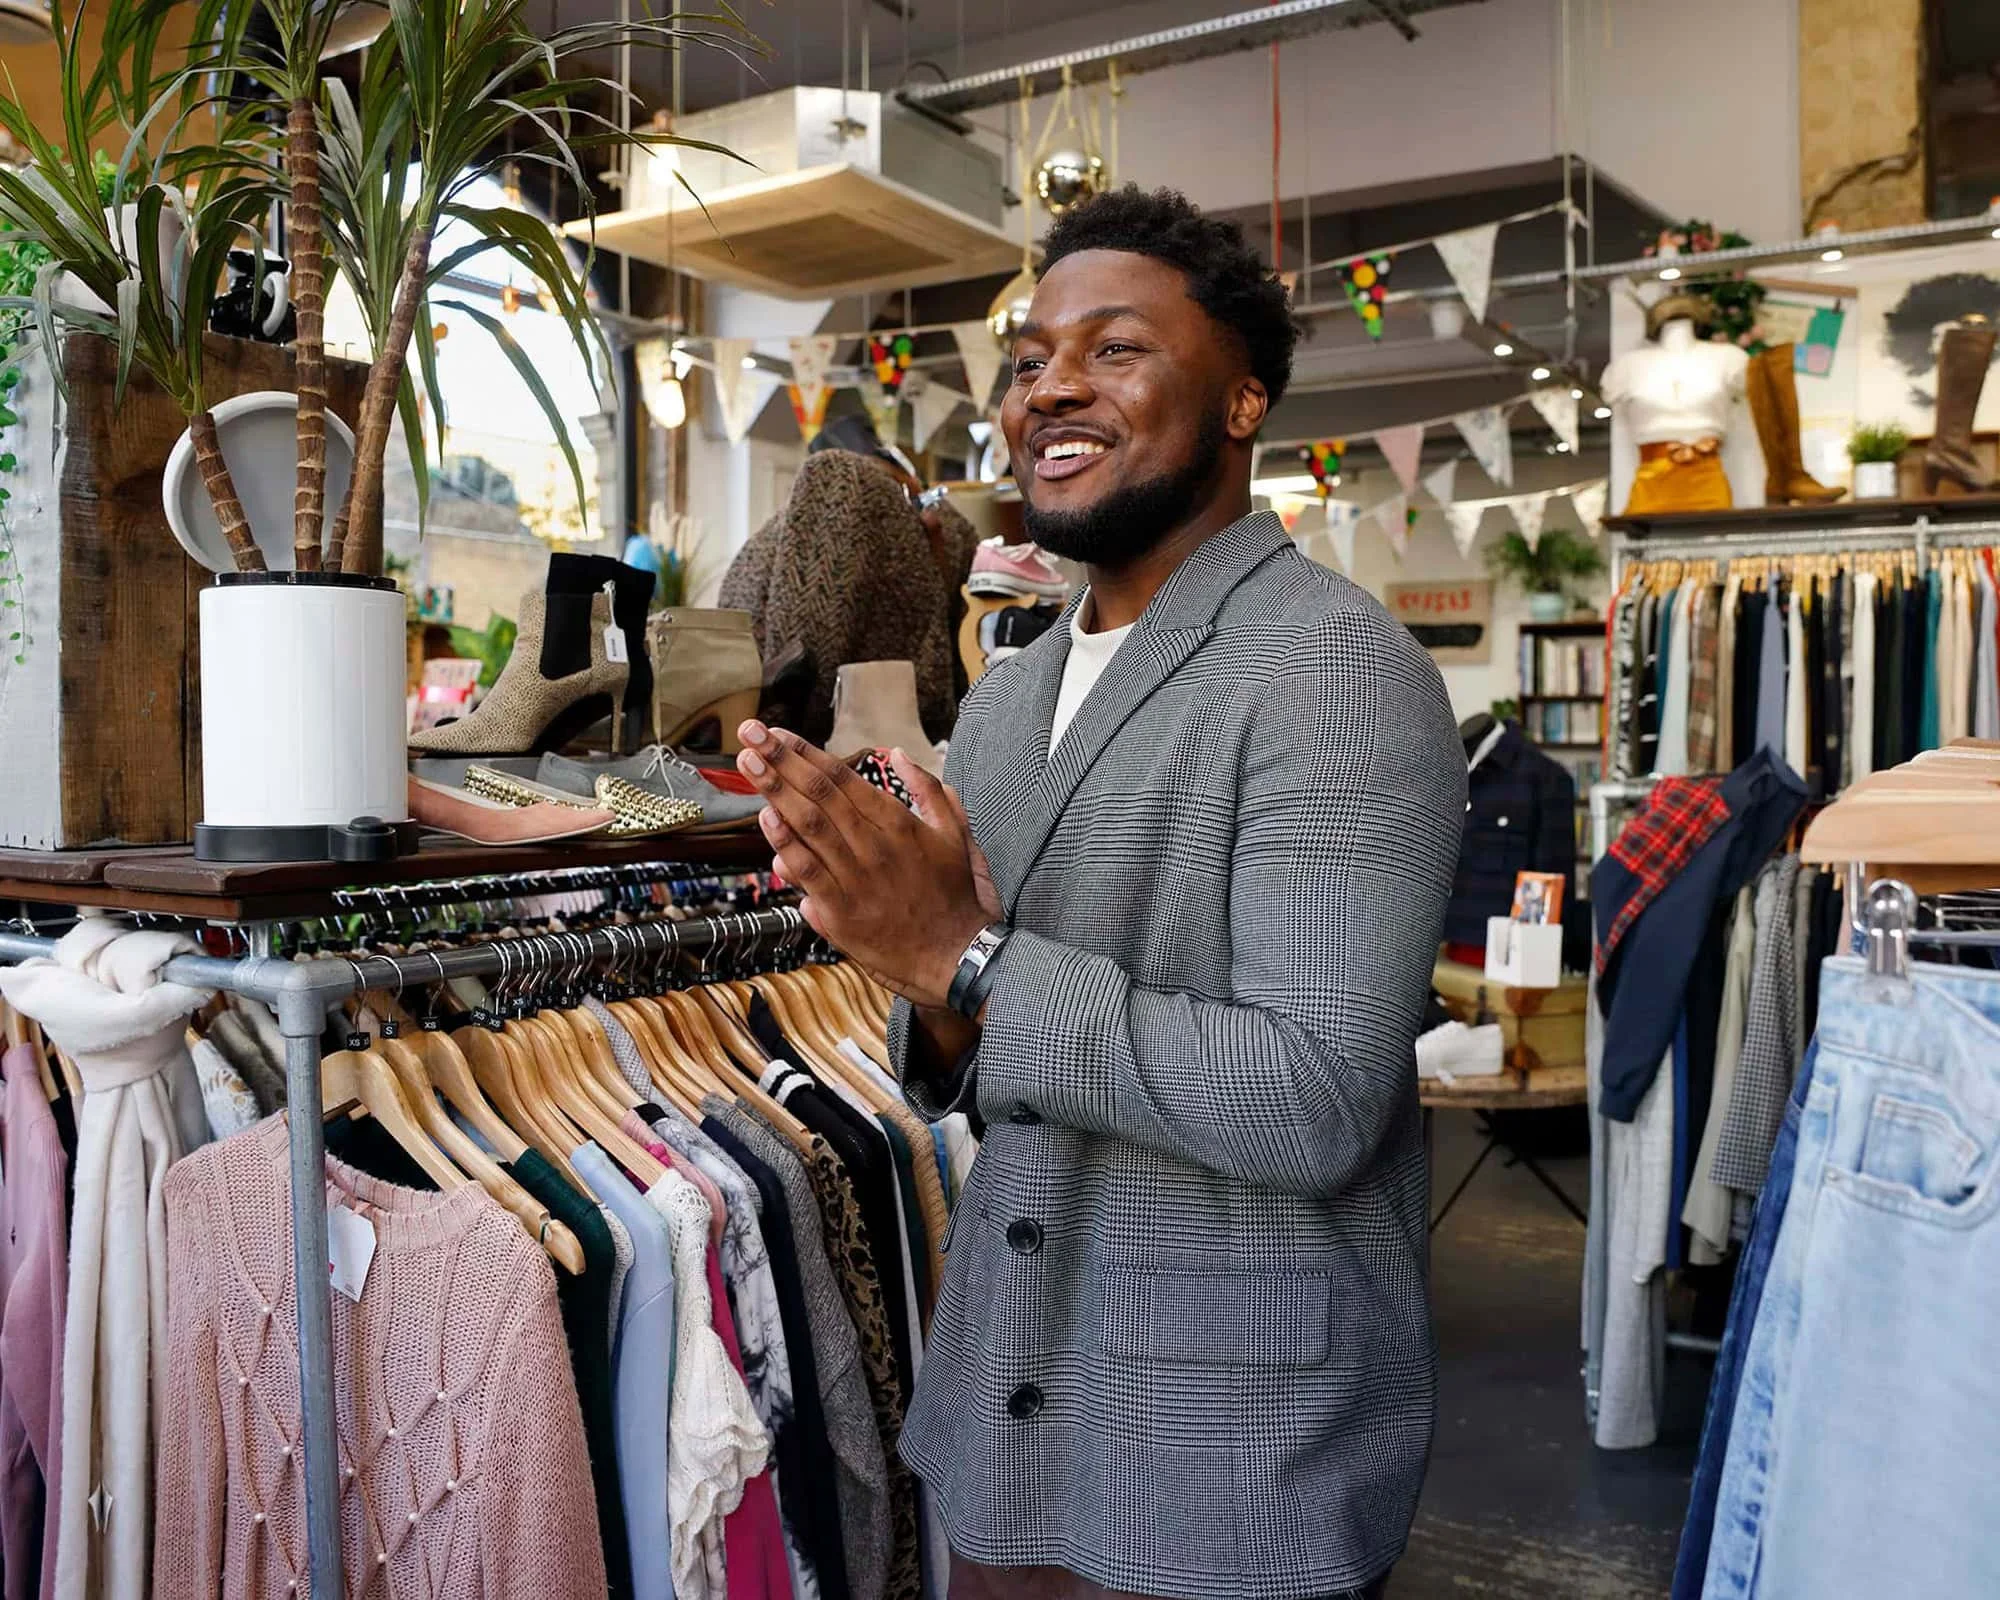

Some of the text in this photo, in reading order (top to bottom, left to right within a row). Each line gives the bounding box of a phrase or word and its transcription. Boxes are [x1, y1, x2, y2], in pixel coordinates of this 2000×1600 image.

[561, 996, 568, 1005] S
[473, 1010, 486, 1021] XS
[424, 1021, 437, 1030] XS
[488, 1018, 501, 1028] XS
[385, 1026, 393, 1036] S
[349, 1039, 361, 1047] XS
